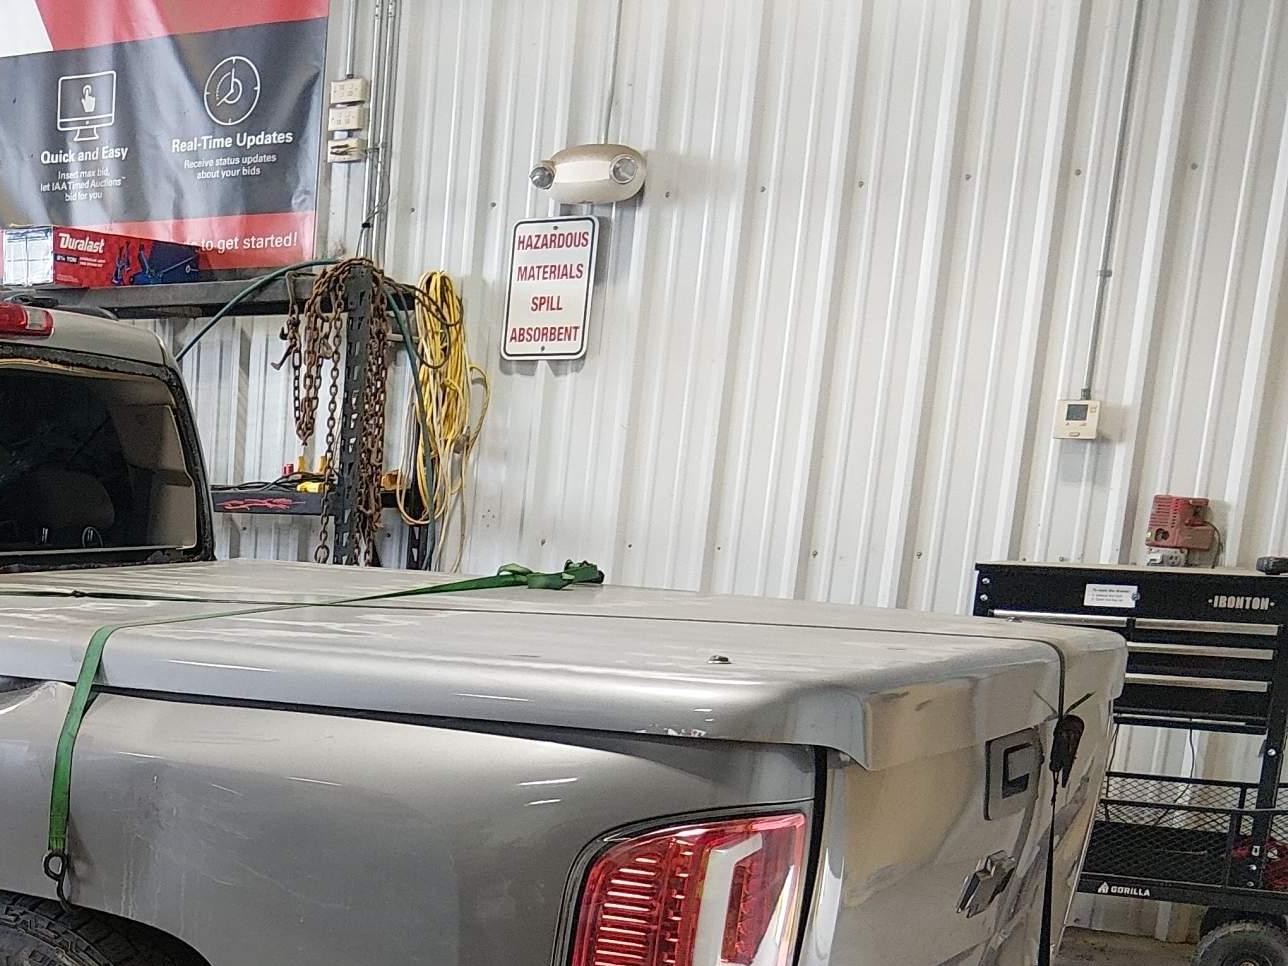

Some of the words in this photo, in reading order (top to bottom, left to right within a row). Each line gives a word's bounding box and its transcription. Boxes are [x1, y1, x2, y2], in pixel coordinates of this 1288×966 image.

[172, 135, 232, 153] Real-Time
[236, 131, 293, 149] Updates
[40, 148, 76, 165] Quick
[77, 146, 99, 161] and
[102, 145, 128, 161] Easy
[184, 158, 214, 169] Receive
[215, 155, 240, 166] status
[242, 153, 277, 165] updates
[79, 170, 96, 179] max
[196, 170, 220, 180] about
[221, 168, 240, 179] your
[242, 166, 261, 176] bids
[40, 182, 50, 192] let
[51, 181, 67, 192] IAA
[67, 180, 90, 190] Timed
[64, 192, 77, 202] bid
[77, 191, 88, 201] for
[89, 191, 103, 201] you
[58, 232, 105, 254] Duralast
[200, 239, 213, 251] to
[217, 236, 239, 254] get
[242, 231, 298, 250] started!
[517, 231, 589, 251] HAZARDOUS
[516, 263, 584, 282] MATERIALS
[530, 295, 563, 312] SPILL
[509, 326, 580, 343] ABSORBENT
[1213, 595, 1270, 611] IRONTON
[1110, 885, 1151, 897] GORILLA
